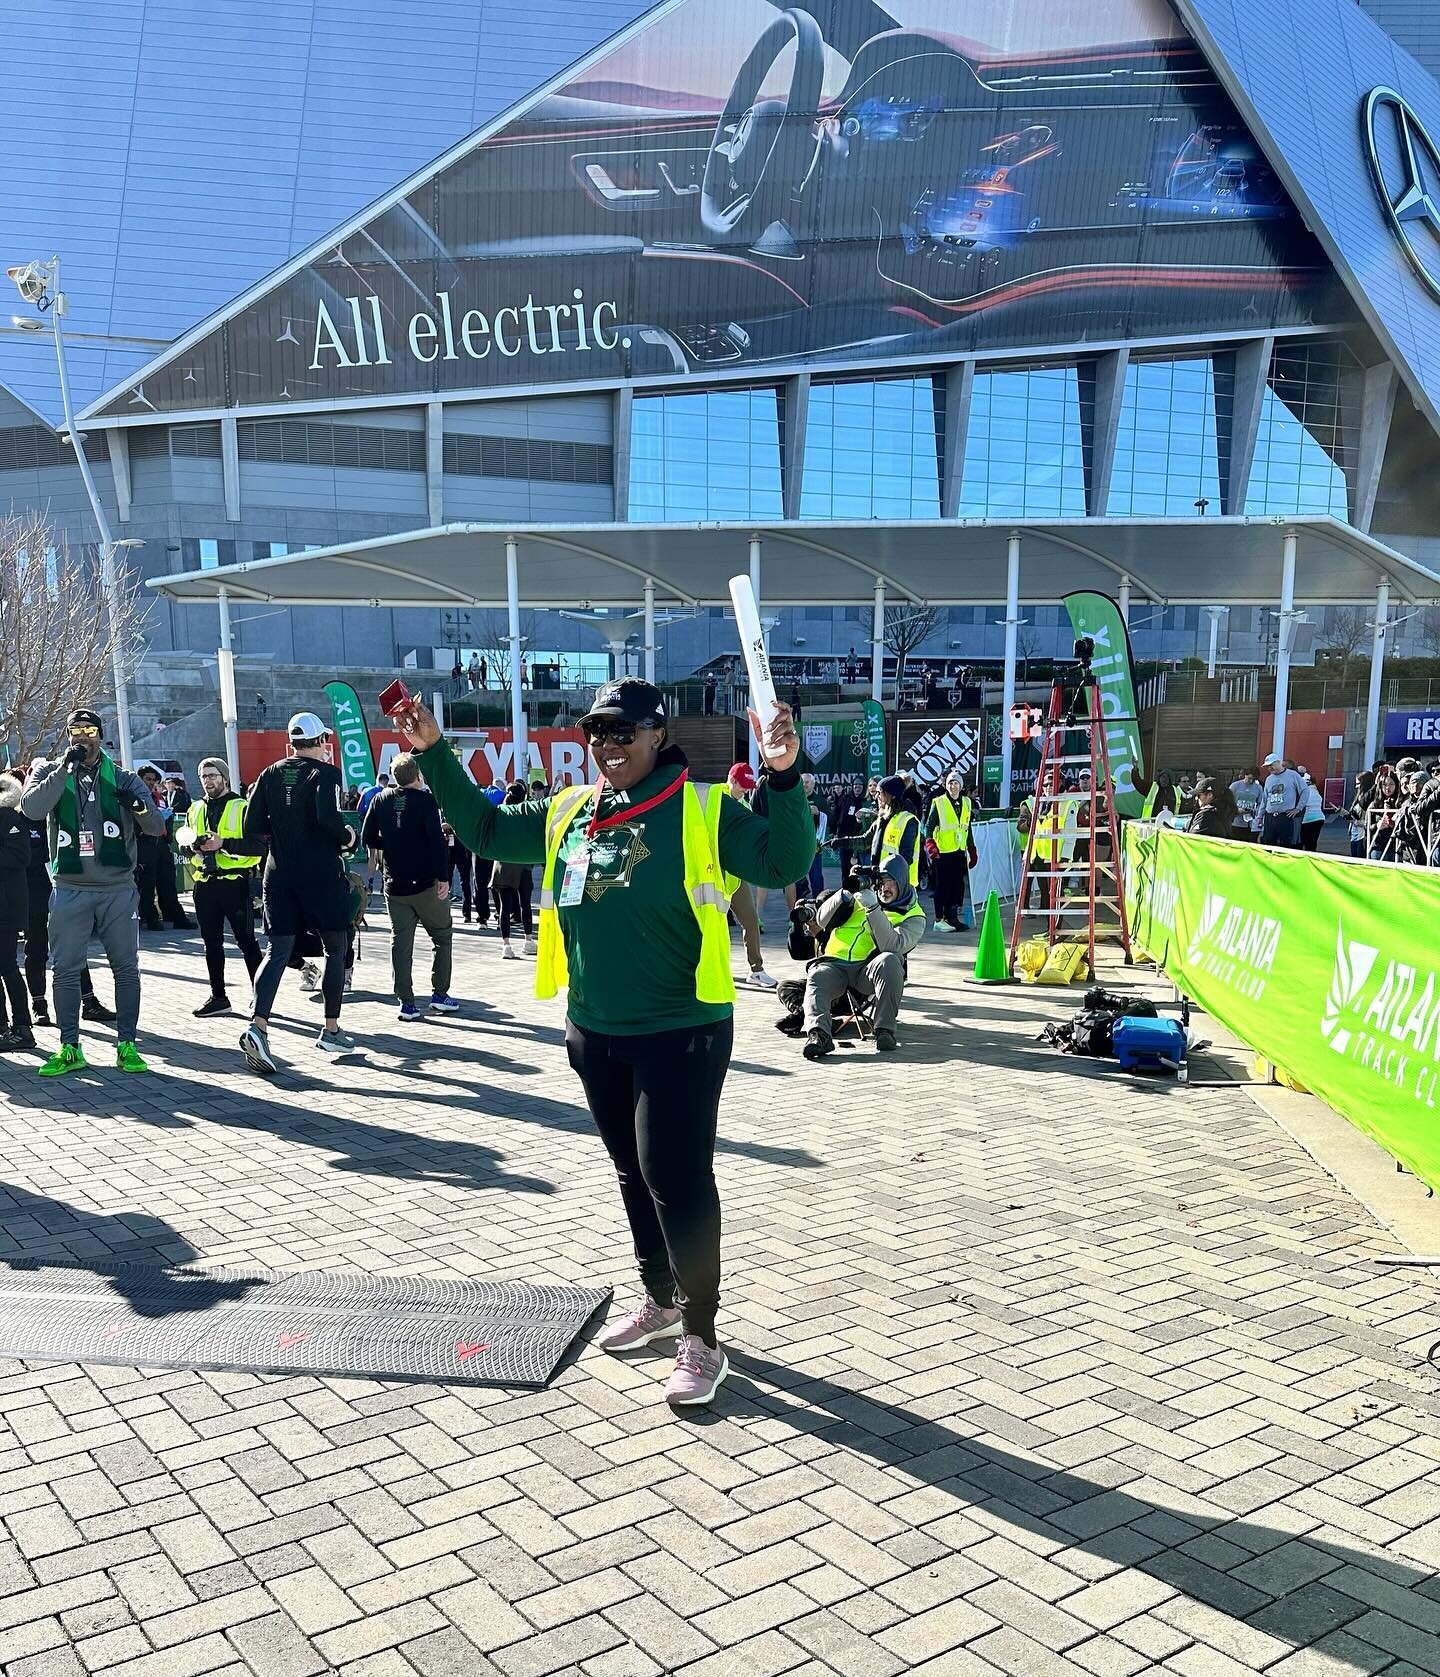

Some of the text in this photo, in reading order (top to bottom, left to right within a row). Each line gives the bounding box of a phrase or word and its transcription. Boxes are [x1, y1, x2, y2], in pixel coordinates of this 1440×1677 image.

[308, 288, 632, 369] All electric.
[757, 652, 770, 681] ATLANTA
[905, 728, 940, 762] THE
[1216, 904, 1282, 974] ATLANTA
[1352, 1031, 1435, 1108] TRACK CL
